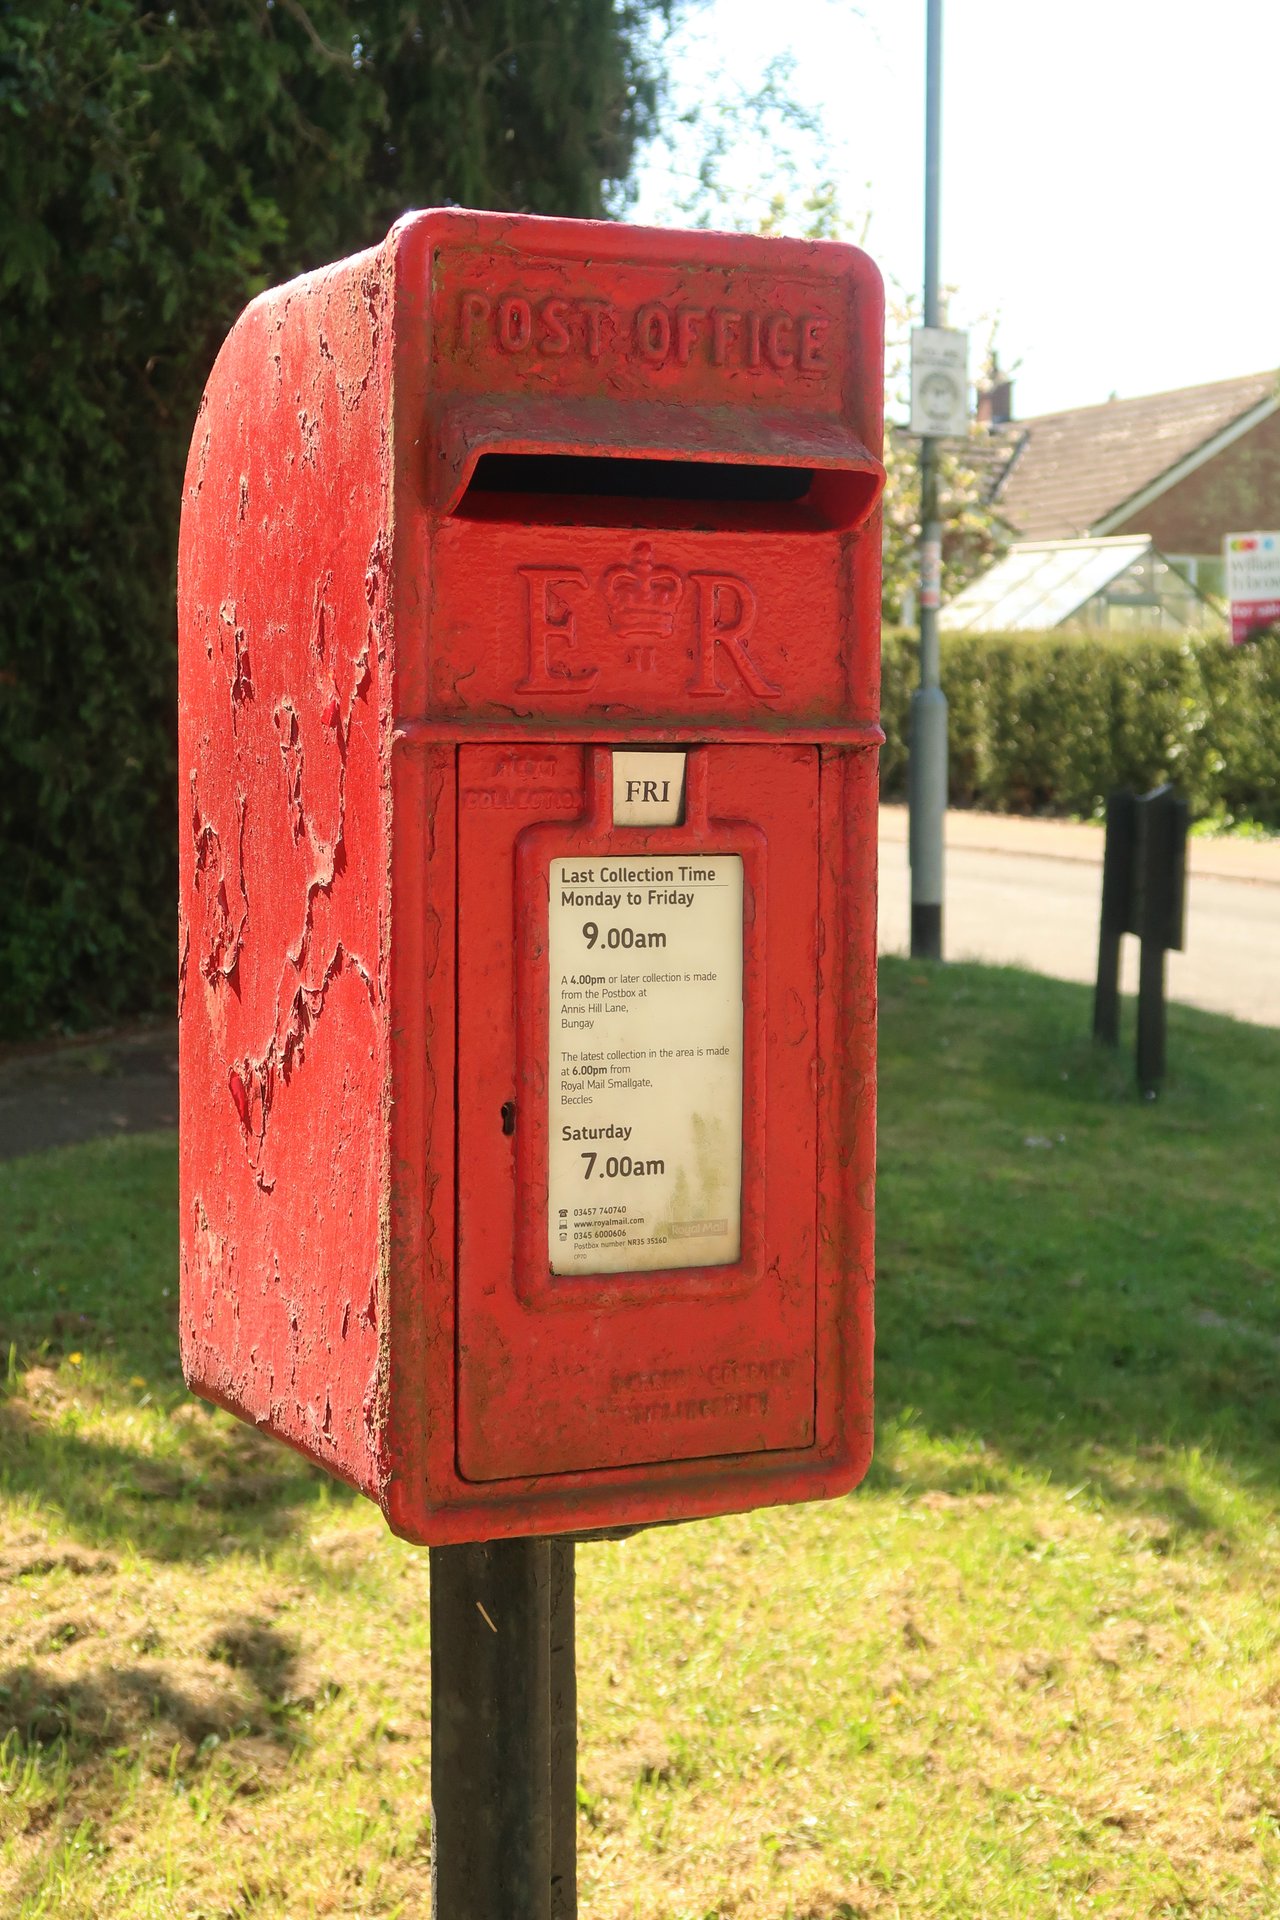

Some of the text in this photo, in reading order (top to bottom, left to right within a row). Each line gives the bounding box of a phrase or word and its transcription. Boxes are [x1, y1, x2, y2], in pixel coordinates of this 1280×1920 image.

[459, 293, 830, 372] POST OFFICE
[515, 565, 782, 699] E R
[625, 780, 671, 802] FRI
[561, 866, 716, 883] Last Collection Time
[561, 890, 695, 909] Monday to Friday
[582, 922, 667, 950] 9.00am
[561, 976, 568, 985] A
[570, 975, 606, 986] 4.00pm
[620, 974, 640, 984] later
[642, 972, 681, 983] collection
[684, 972, 691, 981] is
[693, 972, 717, 981] made
[561, 988, 647, 1000] from the Postbox at
[561, 1003, 629, 1014] Annis Hill Lane,
[561, 1019, 594, 1030] Bungay
[561, 1046, 730, 1061] The latest collection in the area is made
[561, 1064, 631, 1077] at 6.00pm from
[561, 1078, 653, 1092] Royal Mail Smallgate,
[561, 1096, 593, 1105] Beccles
[562, 1124, 632, 1141] Saturday
[581, 1152, 665, 1180] 7.00am
[574, 1206, 627, 1217] 03457 740740
[574, 1217, 645, 1228] www.royalmail.com
[574, 1229, 627, 1240] 0345 6000606
[574, 1242, 599, 1250] Postbox
[600, 1240, 625, 1248] number
[627, 1238, 645, 1246] NR35
